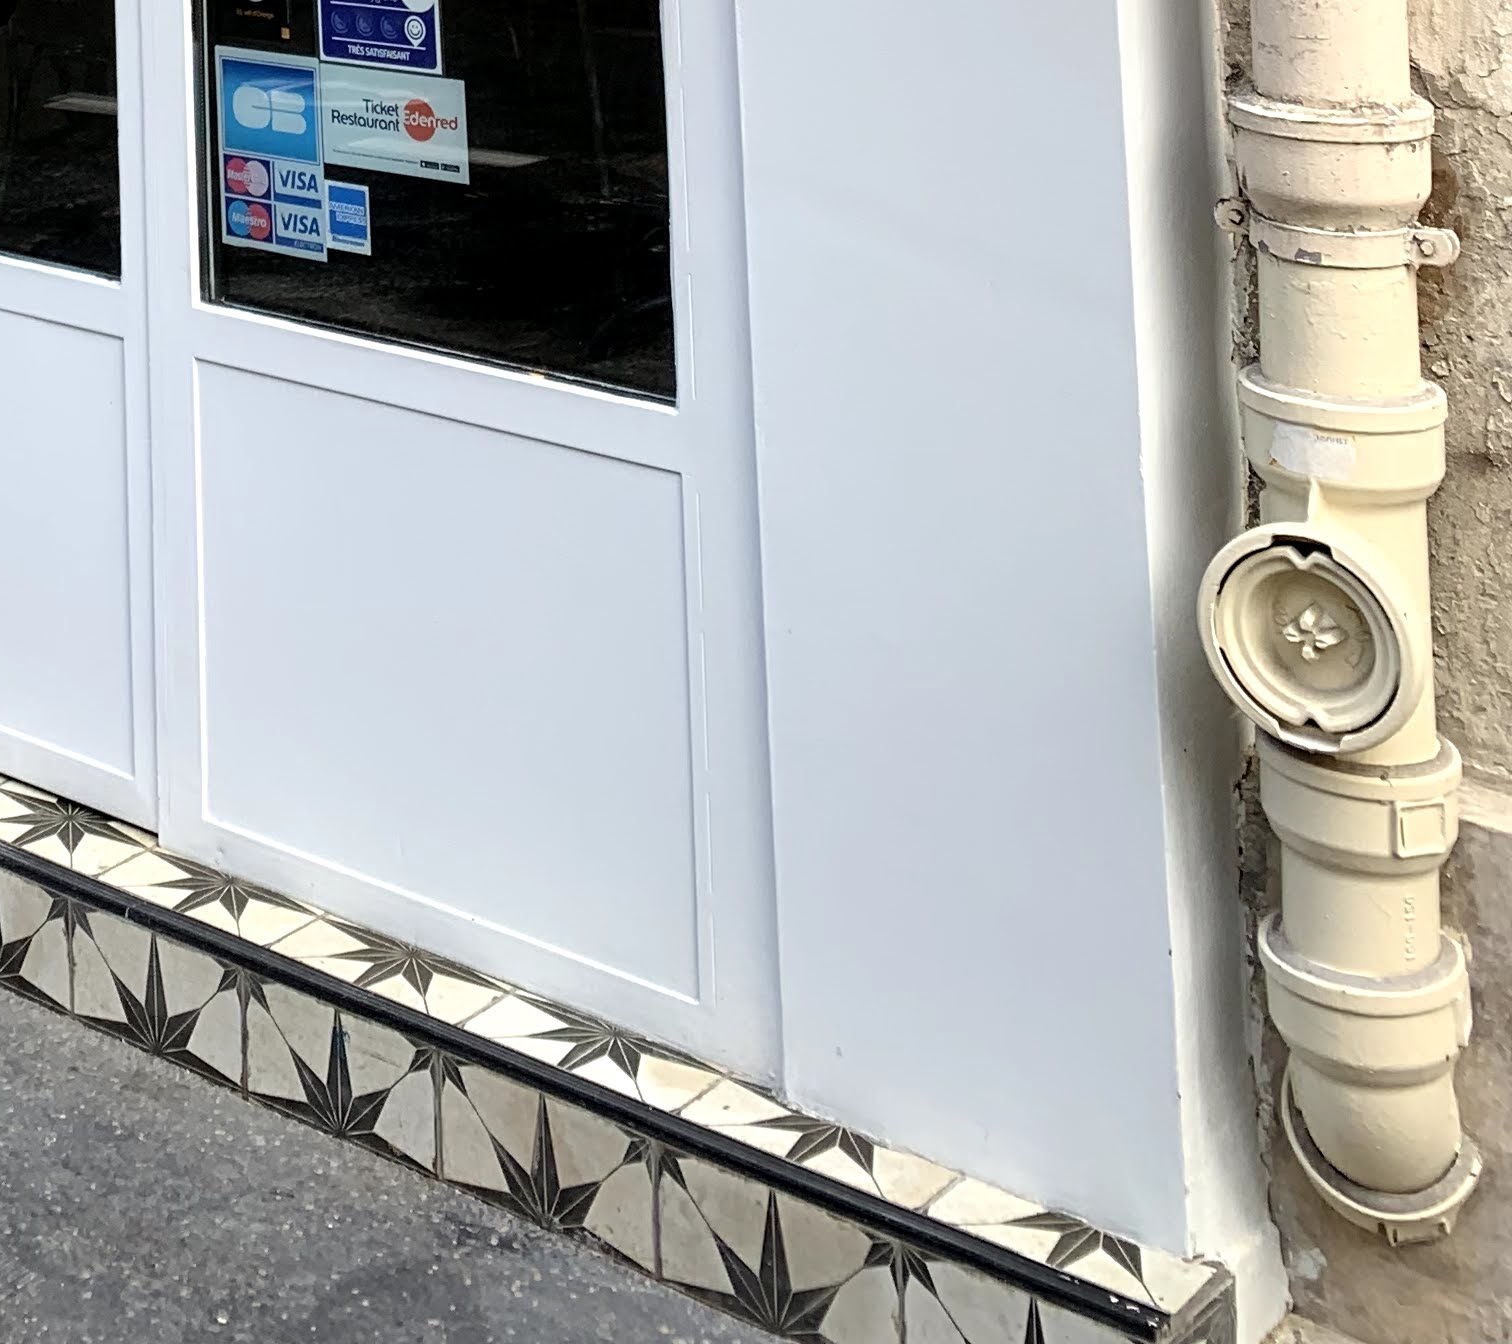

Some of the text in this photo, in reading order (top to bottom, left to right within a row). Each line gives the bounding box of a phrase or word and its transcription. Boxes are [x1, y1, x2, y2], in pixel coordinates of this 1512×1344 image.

[365, 47, 410, 61] SATISFAISANT
[362, 98, 399, 118] Ticket
[331, 109, 400, 132] Restaurant
[403, 110, 458, 131] Edenred
[279, 169, 319, 193] VISA
[281, 212, 321, 236] VISA
